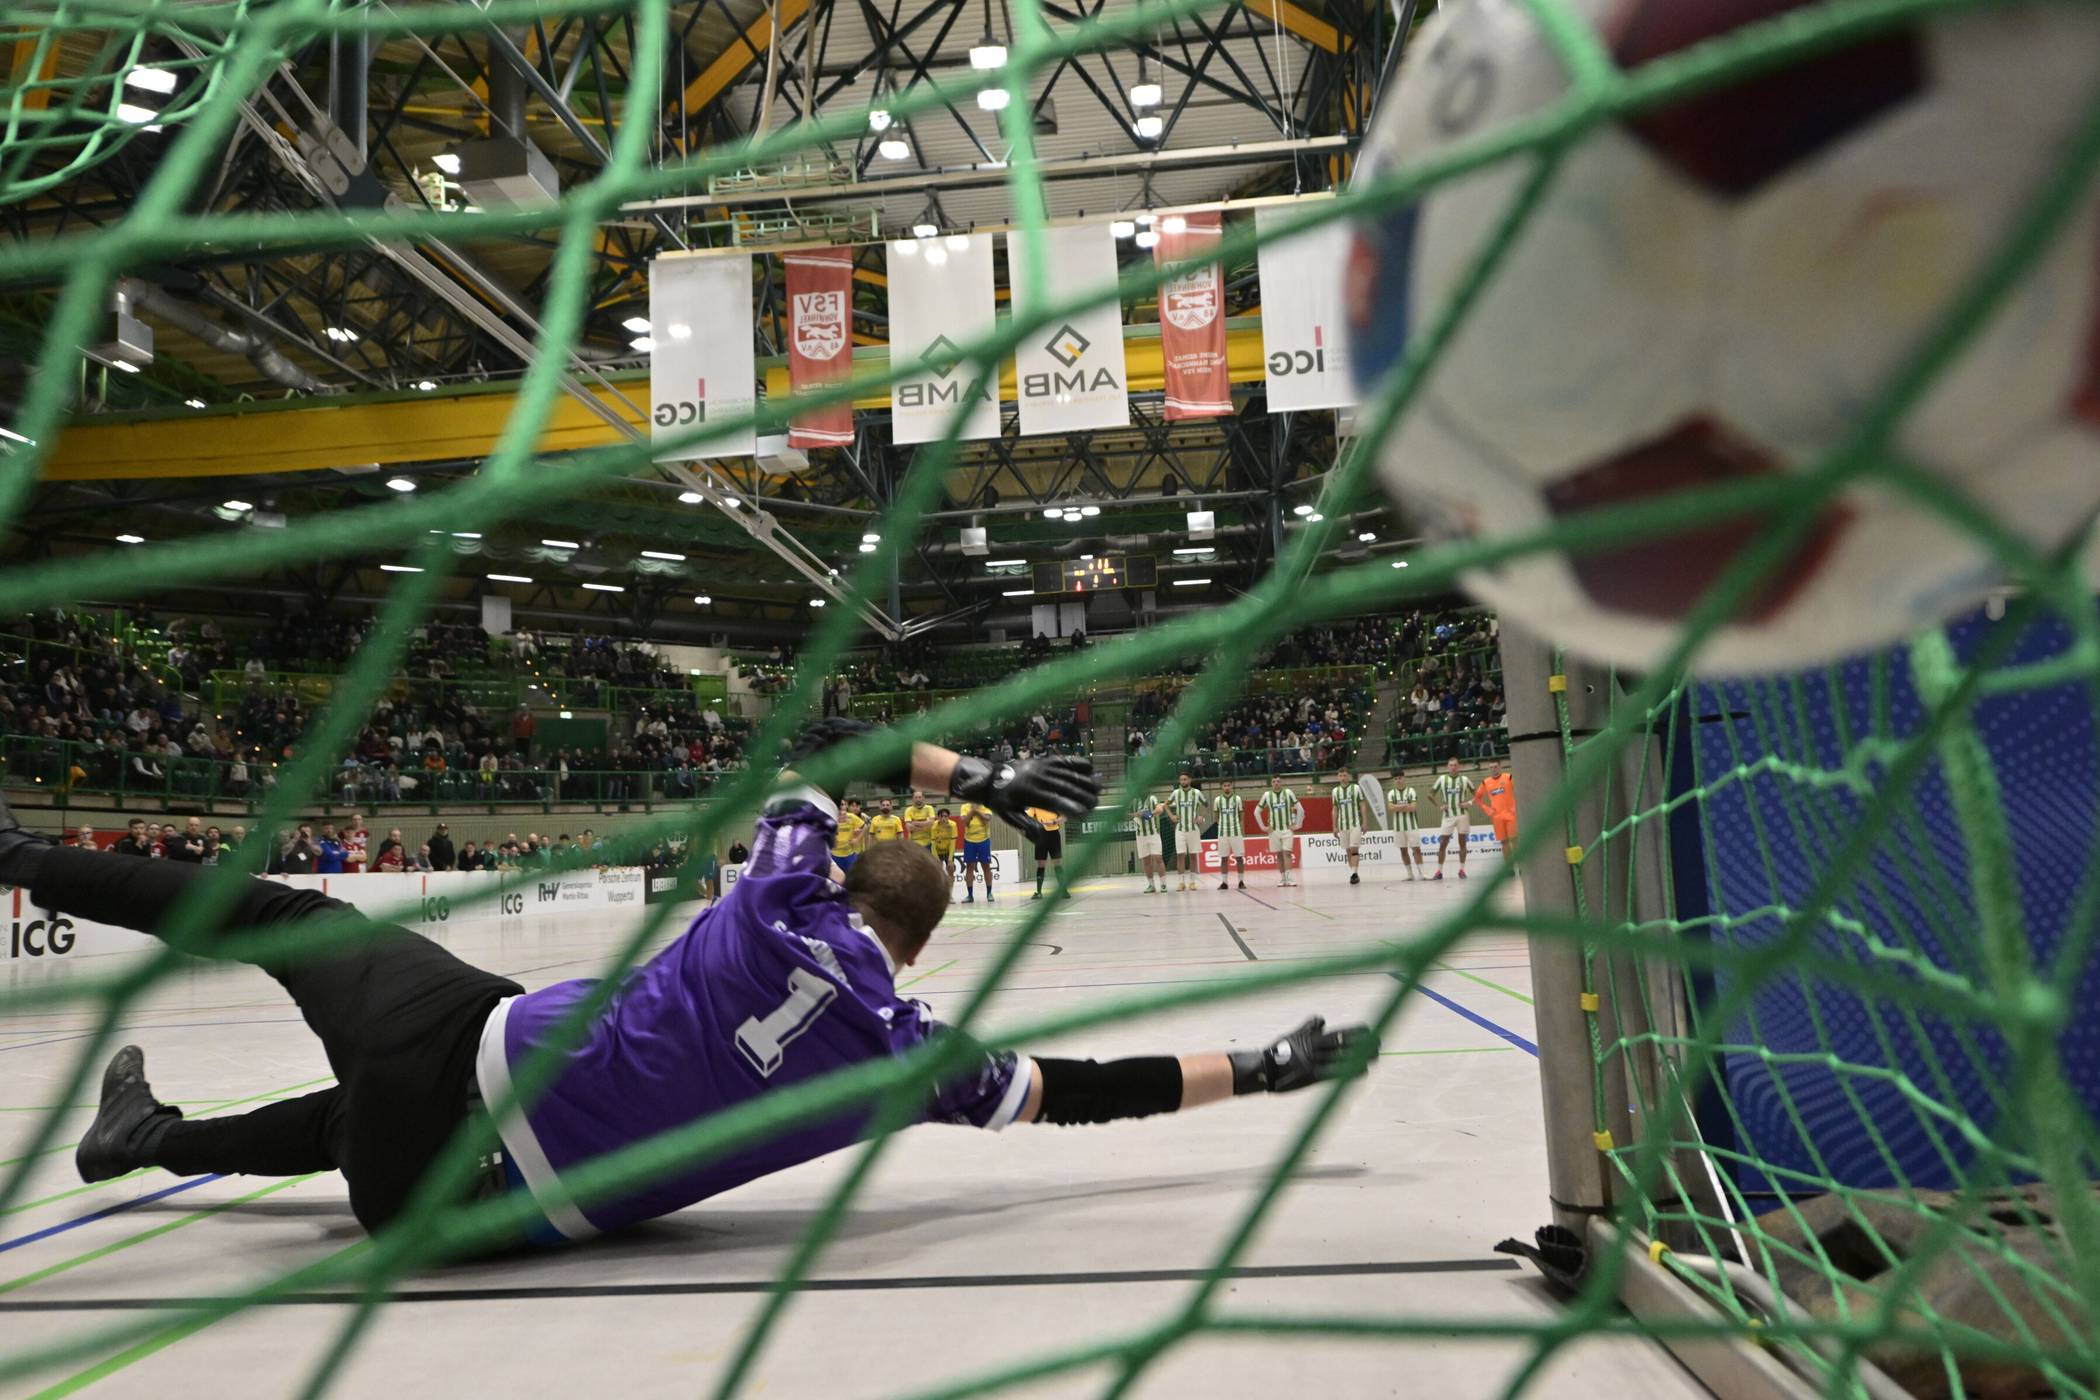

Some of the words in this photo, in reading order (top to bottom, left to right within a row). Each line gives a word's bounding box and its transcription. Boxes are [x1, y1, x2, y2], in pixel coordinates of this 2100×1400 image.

[1360, 835, 1394, 845] entrum
[1326, 850, 1382, 864] Wupertal
[500, 893, 523, 915] ICG
[12, 919, 76, 958] ICG
[735, 966, 838, 1078] 1
